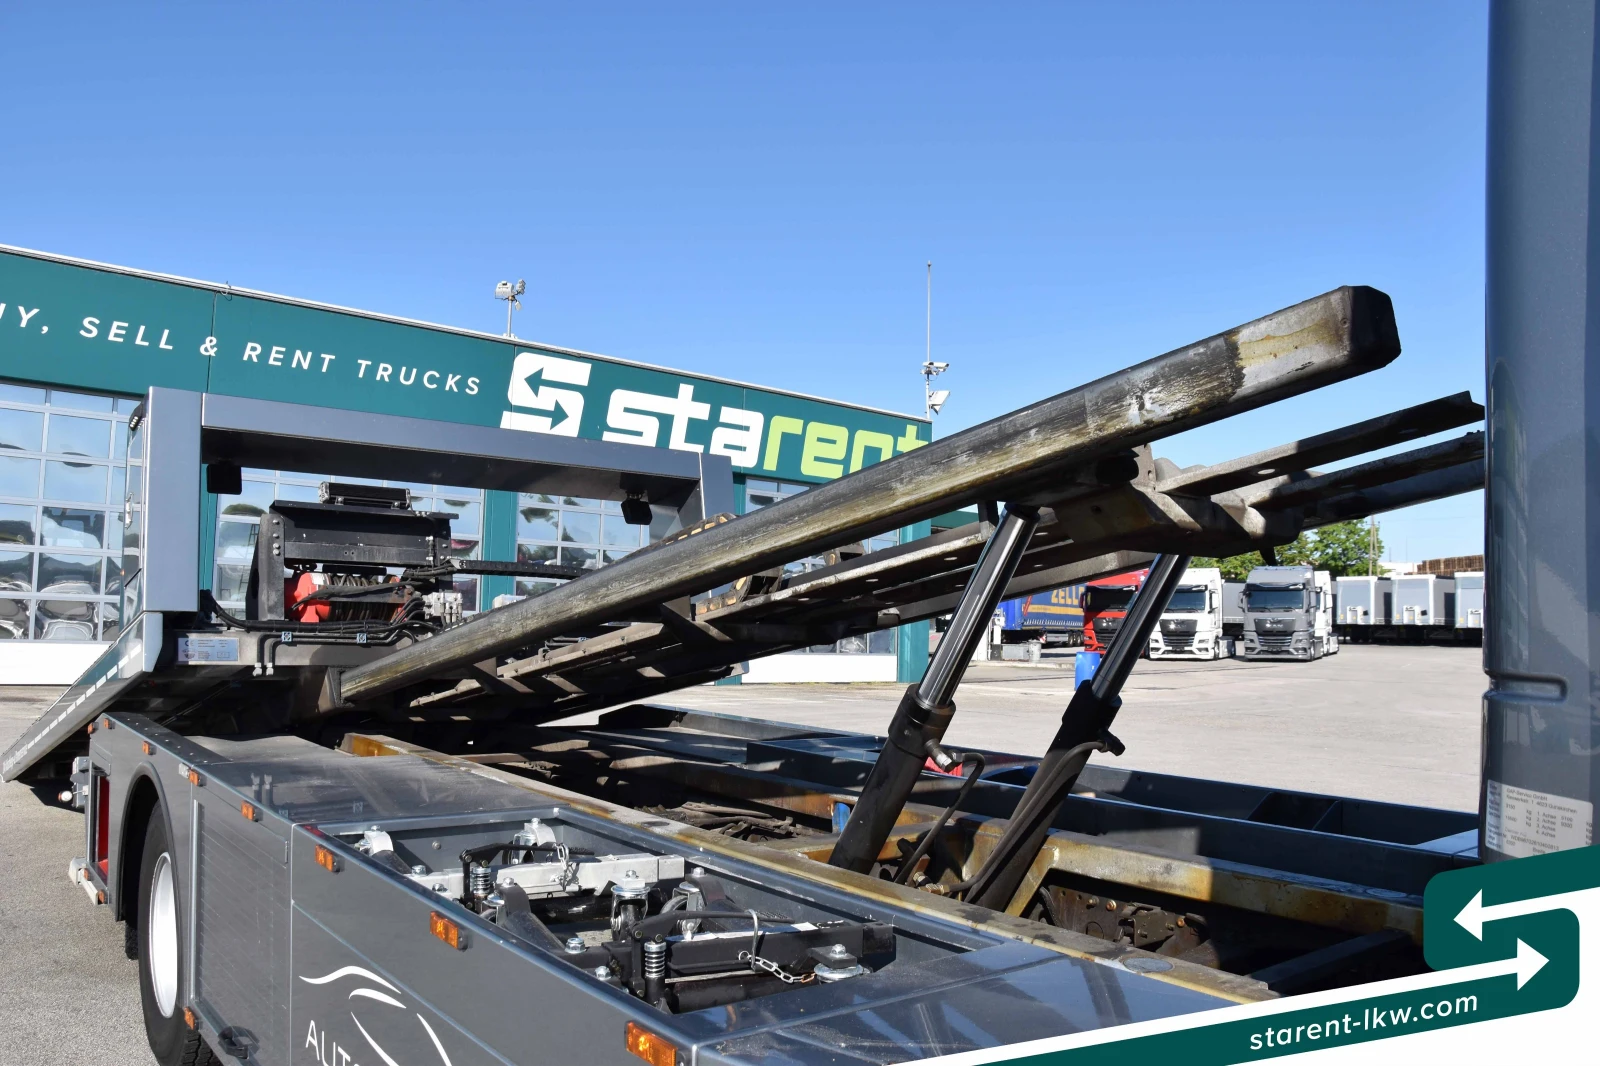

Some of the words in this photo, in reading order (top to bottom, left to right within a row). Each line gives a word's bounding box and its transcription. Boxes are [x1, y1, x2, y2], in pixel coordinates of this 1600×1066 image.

[79, 316, 174, 350] SELL
[199, 336, 218, 357] &
[242, 341, 336, 373] RENT
[357, 359, 481, 396] TRUCKS
[305, 1020, 360, 1066] AUT
